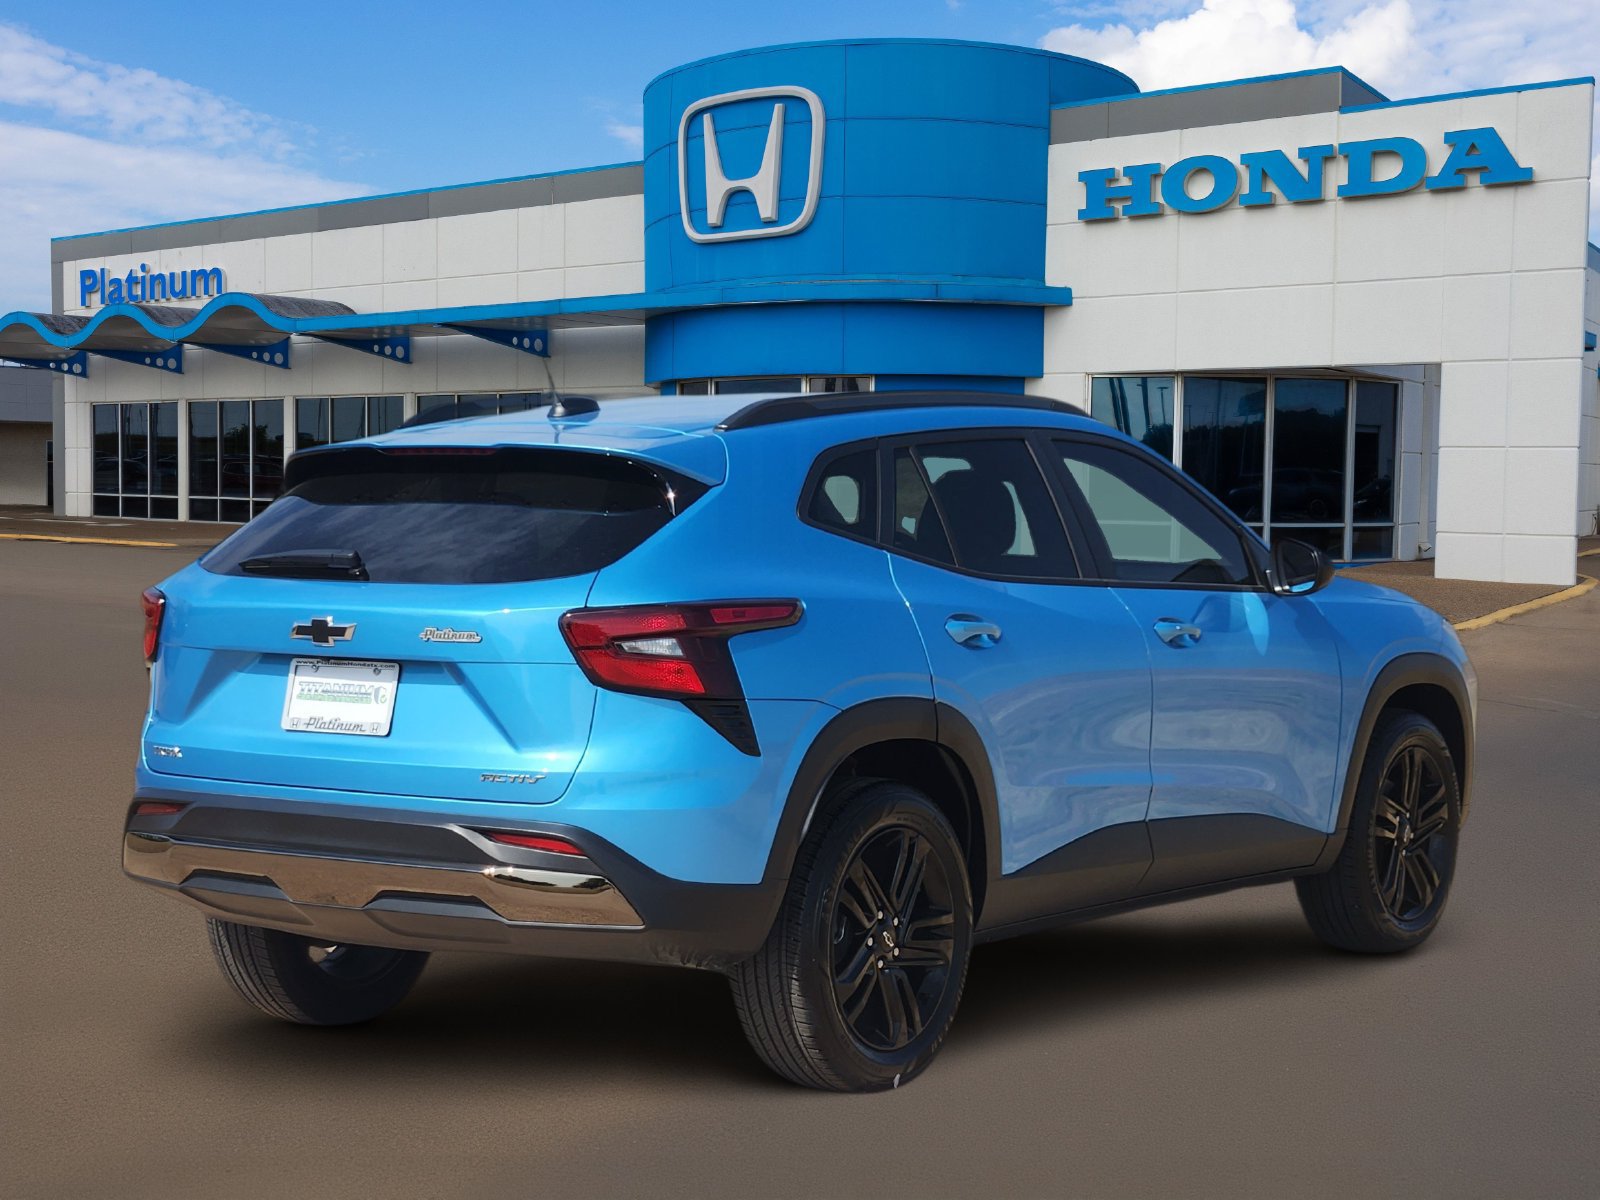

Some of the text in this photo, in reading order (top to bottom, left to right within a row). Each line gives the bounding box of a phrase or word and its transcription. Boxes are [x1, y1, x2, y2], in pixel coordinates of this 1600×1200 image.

[1078, 127, 1534, 222] HONDA
[80, 263, 226, 307] Platinum
[420, 627, 482, 643] Platinum
[304, 716, 367, 732] Platinum
